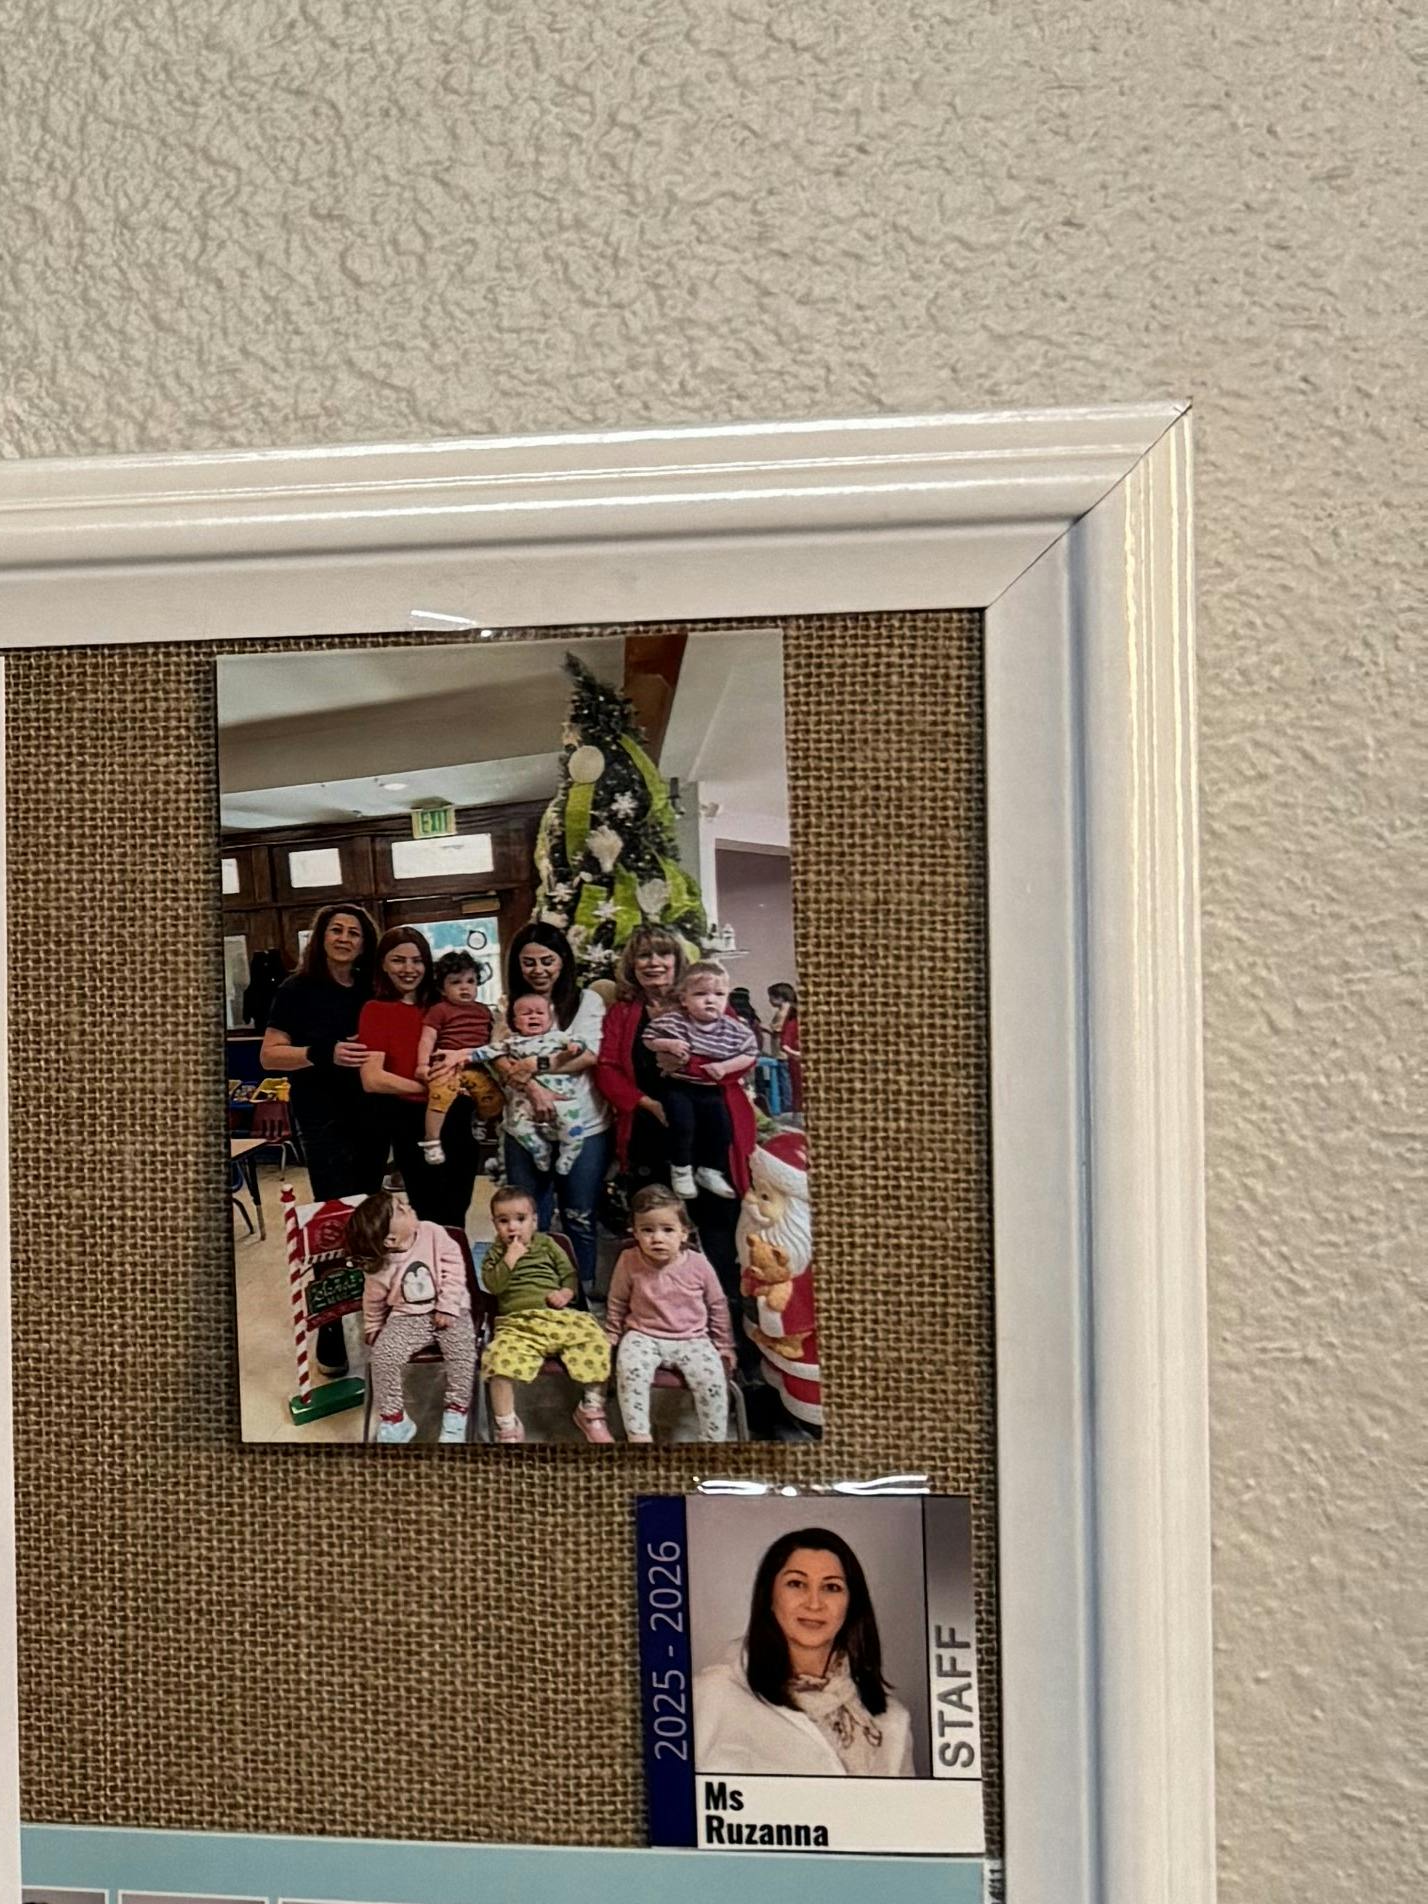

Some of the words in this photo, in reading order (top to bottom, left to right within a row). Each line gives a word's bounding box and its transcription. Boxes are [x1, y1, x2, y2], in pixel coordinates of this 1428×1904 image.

[646, 1540, 684, 1634] 2026
[652, 1669, 689, 1762] 2025
[934, 1624, 976, 1769] STAFF
[704, 1781, 744, 1811] Ms
[706, 1815, 829, 1847] Ruzanna
